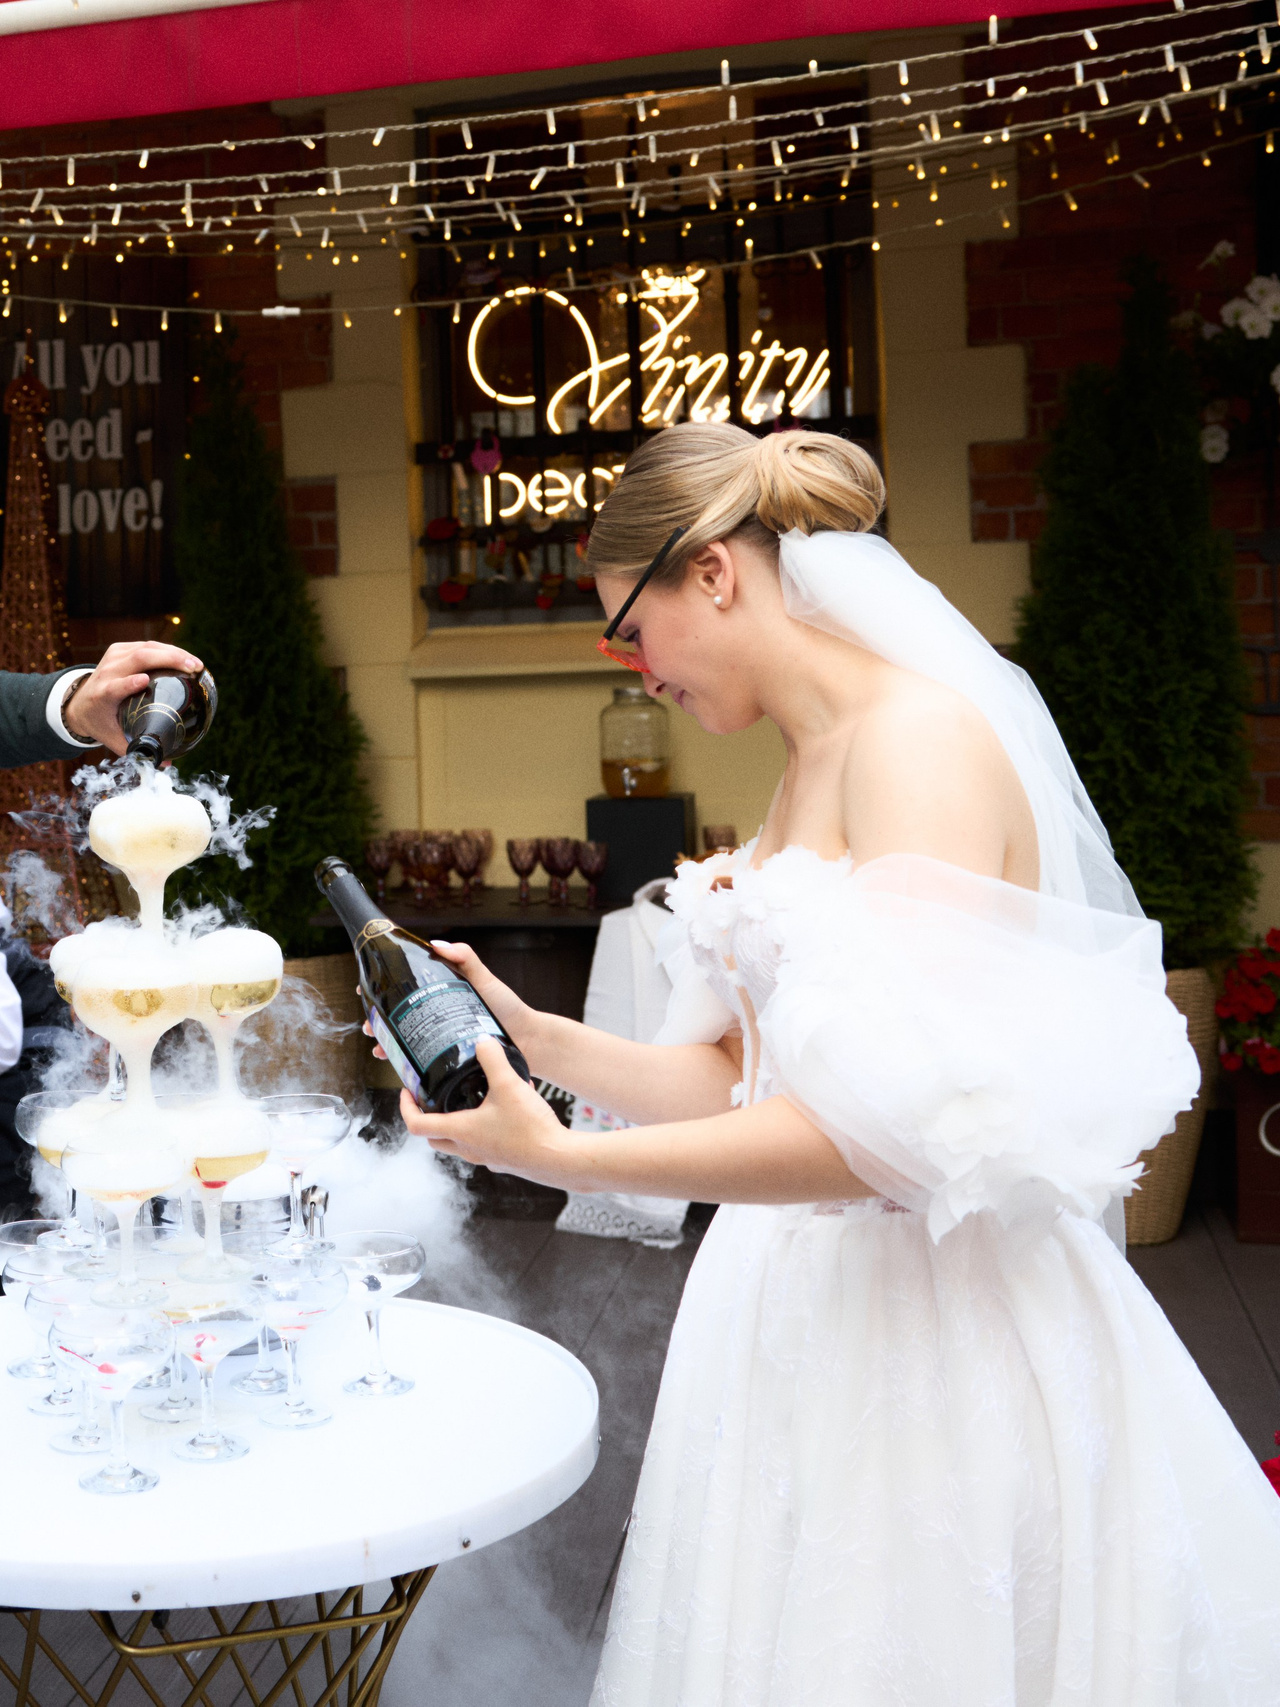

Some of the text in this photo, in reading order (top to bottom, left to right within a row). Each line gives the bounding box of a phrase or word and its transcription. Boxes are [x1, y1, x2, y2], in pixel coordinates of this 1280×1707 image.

[80, 339, 162, 395] you
[467, 286, 831, 435] Vinity
[44, 407, 124, 463] eed
[56, 478, 165, 537] love!
